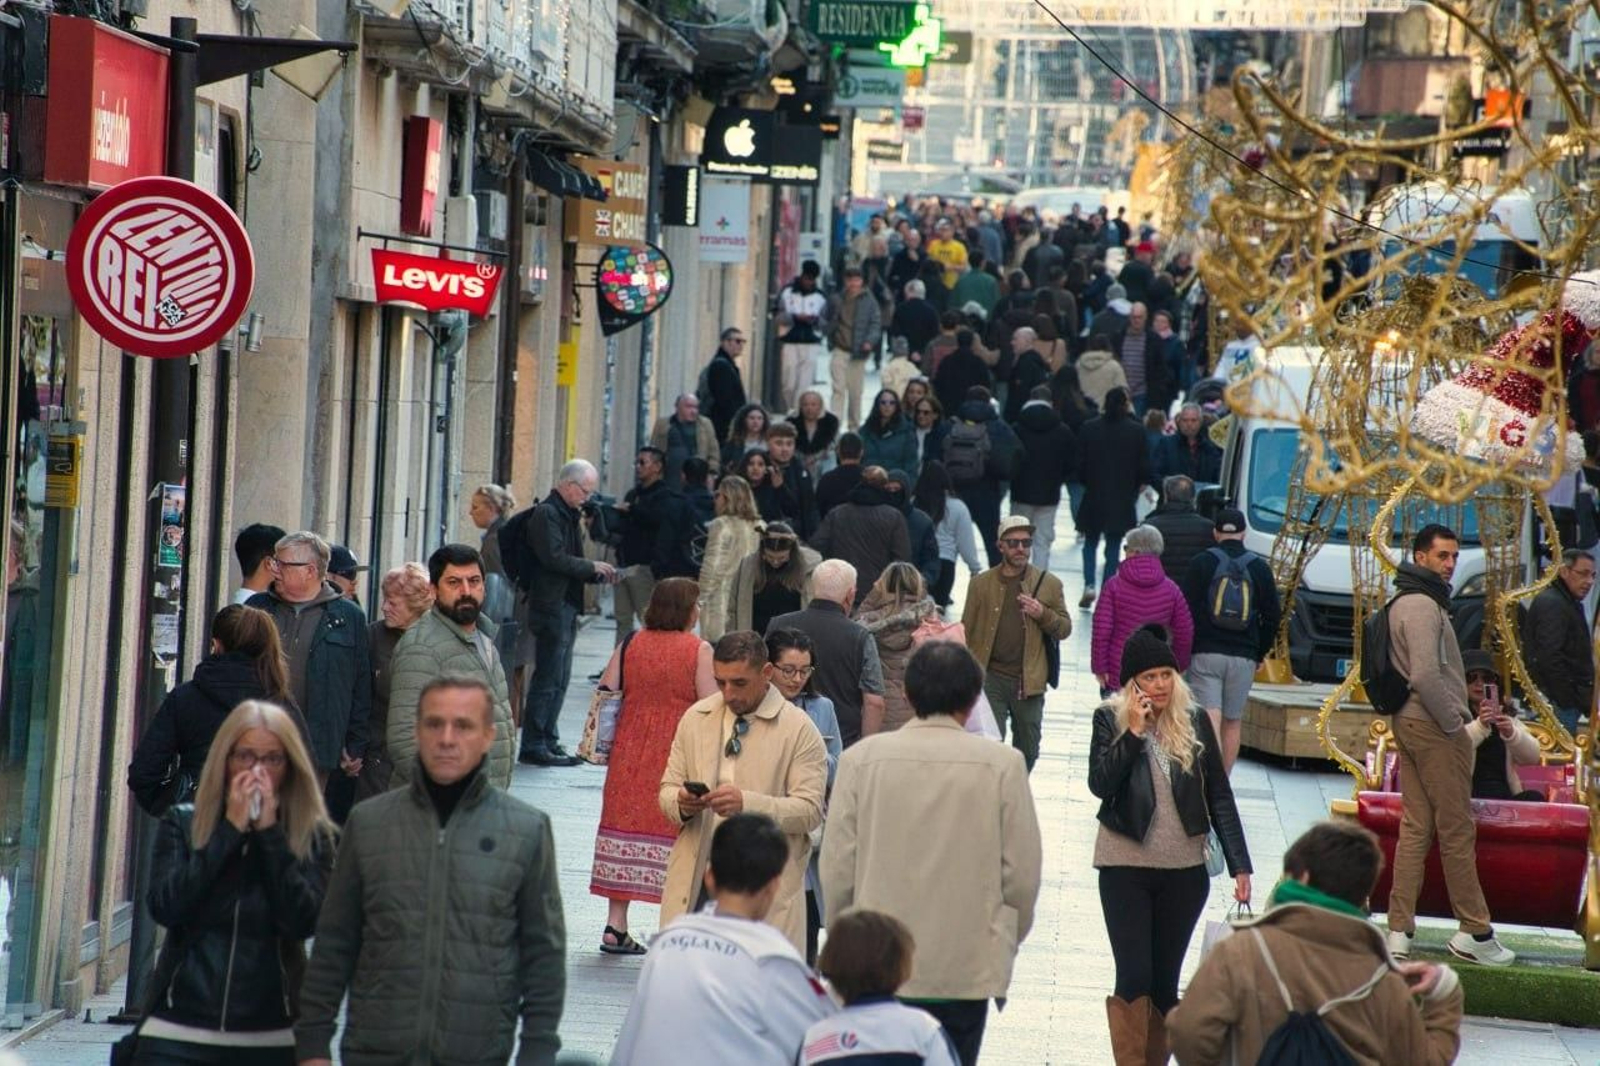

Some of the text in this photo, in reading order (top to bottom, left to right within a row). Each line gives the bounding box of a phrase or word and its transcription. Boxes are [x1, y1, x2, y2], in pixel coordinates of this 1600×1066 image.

[818, 4, 906, 36] RESIDENCIA
[163, 296, 186, 320] FCK
[660, 936, 738, 957] ENGLAND
